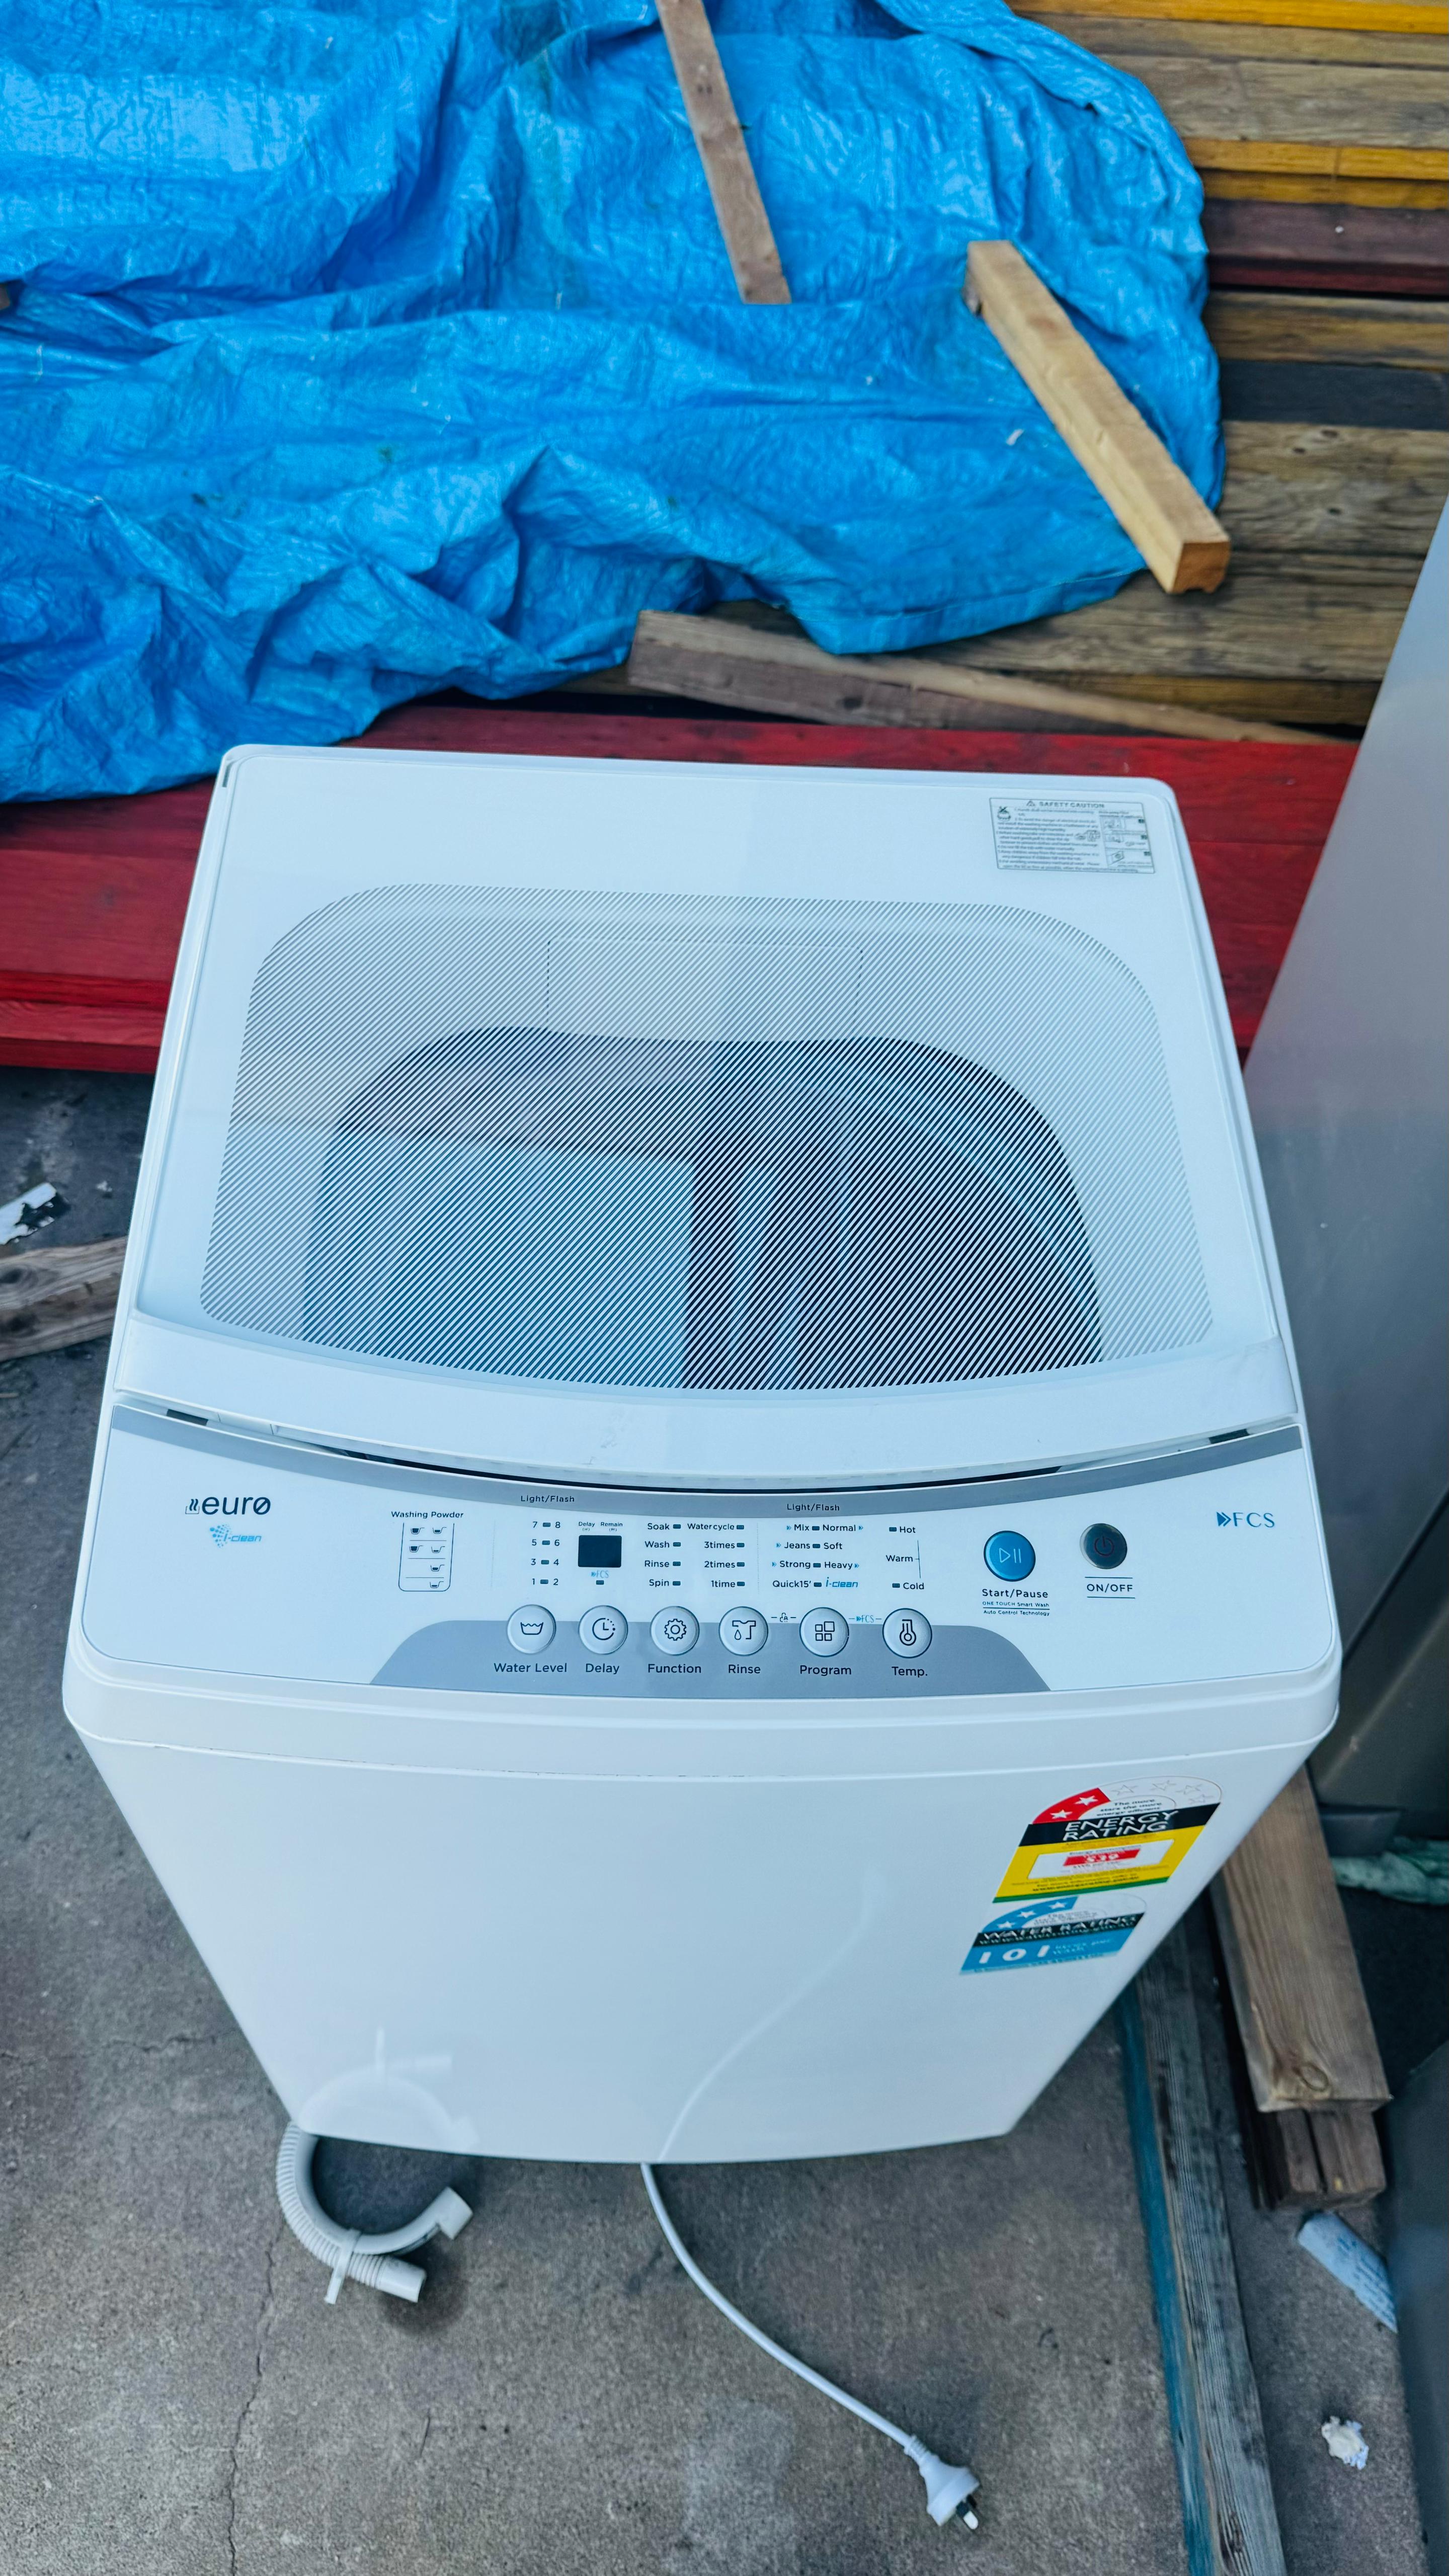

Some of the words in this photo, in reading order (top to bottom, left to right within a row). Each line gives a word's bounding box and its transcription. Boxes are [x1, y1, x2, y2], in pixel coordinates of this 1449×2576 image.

[787, 1503, 839, 1511] Light/Flash
[1233, 1512, 1274, 1527] FCS
[780, 1561, 811, 1569] Strong
[825, 1562, 852, 1570] Heavy
[596, 1570, 609, 1578] FCS
[650, 1579, 669, 1587] Spin
[1087, 1583, 1133, 1592] ON/OFF
[982, 1589, 1048, 1598] Start/Pause
[494, 1663, 531, 1672] Water
[535, 1663, 567, 1672] Level
[586, 1663, 619, 1674] Delay
[648, 1664, 701, 1673] Function
[729, 1664, 761, 1673] Rinse
[800, 1665, 851, 1676] Program
[892, 1666, 927, 1677] Temp.
[1065, 1811, 1178, 1831] ENERGY
[1063, 1821, 1168, 1841] RATING
[984, 1926, 1053, 1940] WATER
